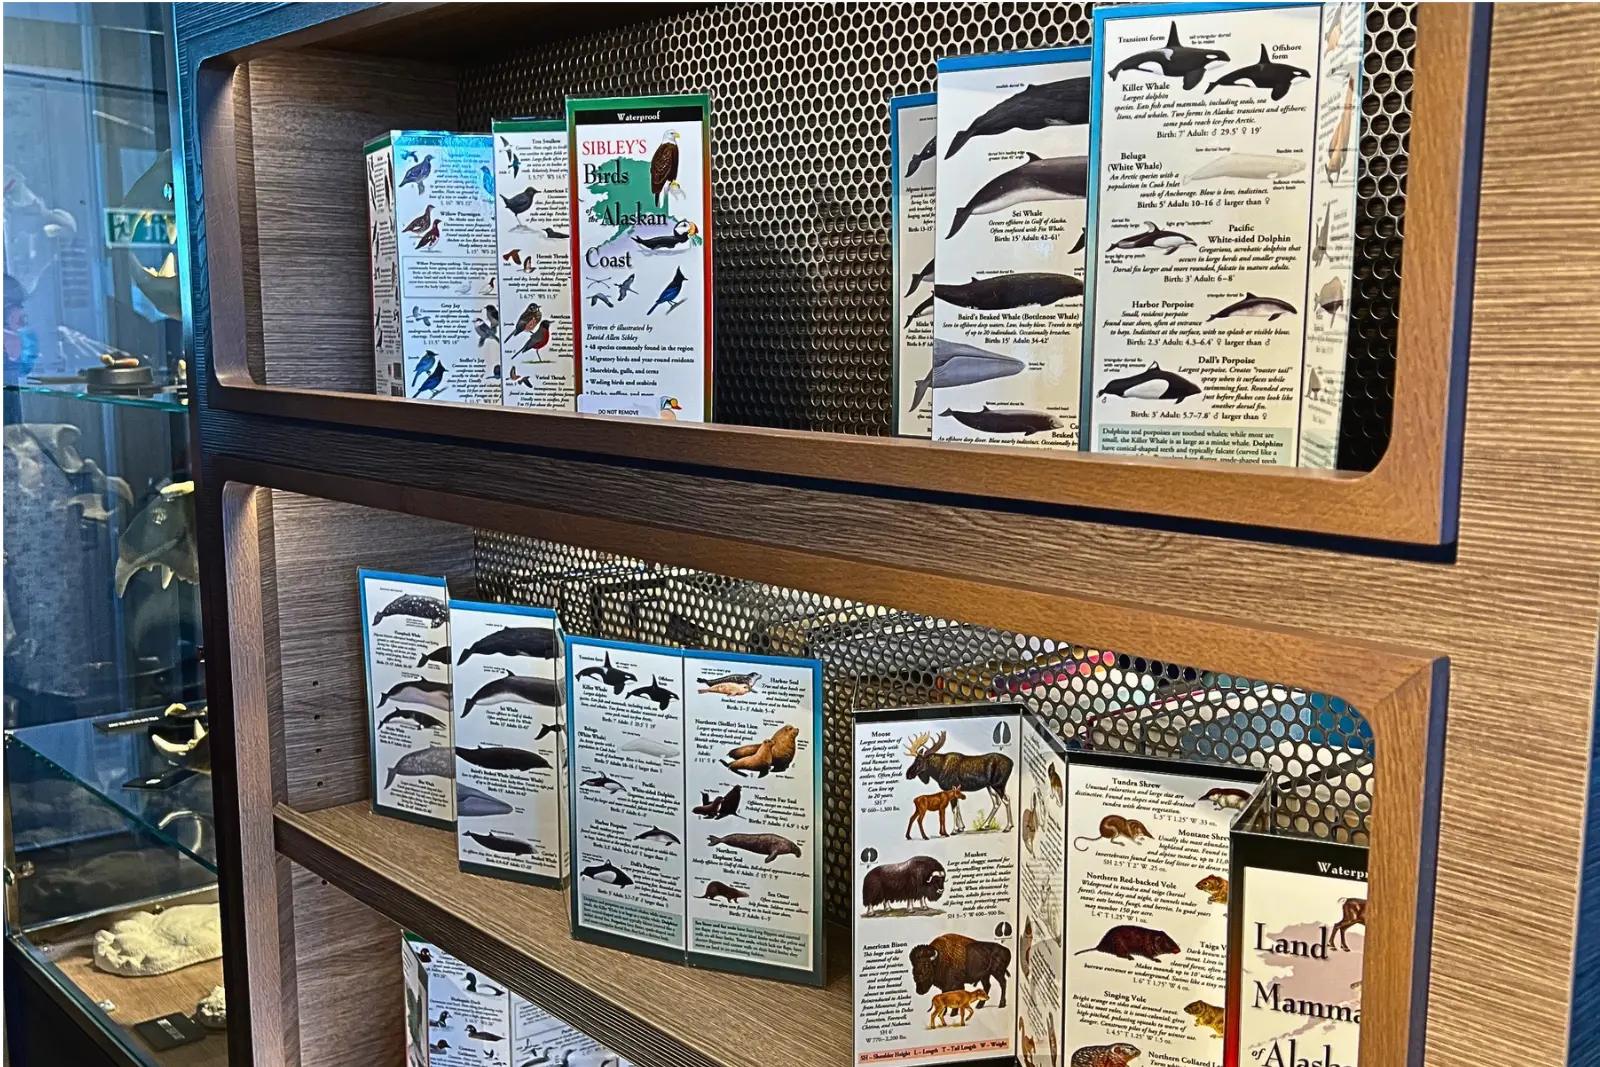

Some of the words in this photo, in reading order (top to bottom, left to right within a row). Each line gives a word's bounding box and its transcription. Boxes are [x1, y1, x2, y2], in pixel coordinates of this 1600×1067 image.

[617, 110, 660, 121] Waterproof
[582, 139, 647, 155] SIBLEY'S
[583, 160, 629, 184] Birds
[586, 207, 594, 215] of
[601, 202, 668, 226] Alaskan
[588, 214, 599, 223] the
[586, 247, 632, 268] Coast
[645, 324, 652, 333] by
[621, 334, 637, 342] Sibley
[590, 379, 610, 387] Wading
[1113, 777, 1137, 787] Tundra
[1139, 780, 1160, 789] Shrew
[1085, 783, 1108, 791] Unusual
[1149, 789, 1162, 798] large
[1178, 828, 1209, 838] Montane
[1086, 872, 1117, 882] Northern
[1119, 875, 1159, 887] Red-backed
[1161, 880, 1176, 889] Vole
[863, 942, 890, 950] American
[1200, 941, 1219, 951] Taiga
[1254, 922, 1328, 960] Land
[1104, 990, 1129, 1002] Singing
[1131, 994, 1146, 1003] Vole
[1148, 1050, 1179, 1062] Northern
[1181, 1054, 1210, 1066] Collared
[1252, 1048, 1266, 1060] of
[1262, 1038, 1351, 1067] Alask
